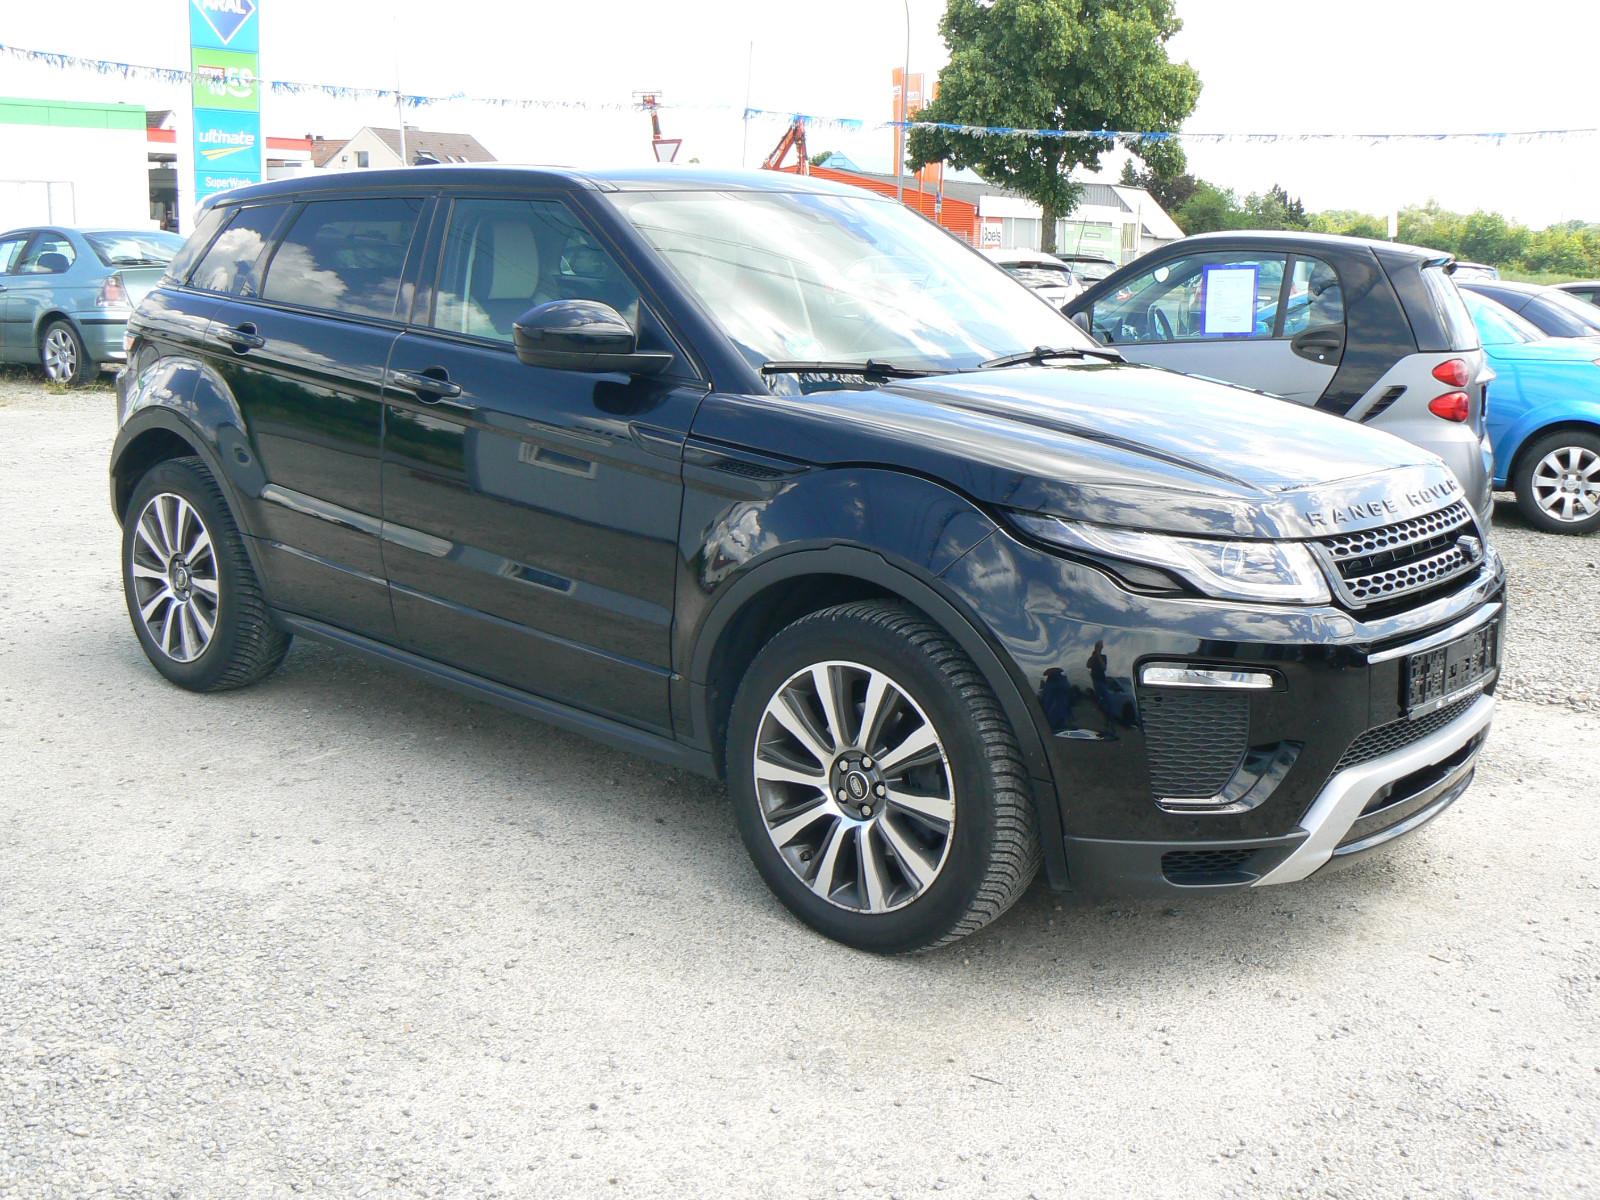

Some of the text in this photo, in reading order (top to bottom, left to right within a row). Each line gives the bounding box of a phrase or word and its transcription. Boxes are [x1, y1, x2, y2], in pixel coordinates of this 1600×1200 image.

[199, 128, 255, 145] ultimate
[1305, 479, 1458, 527] RANGE ROVER
